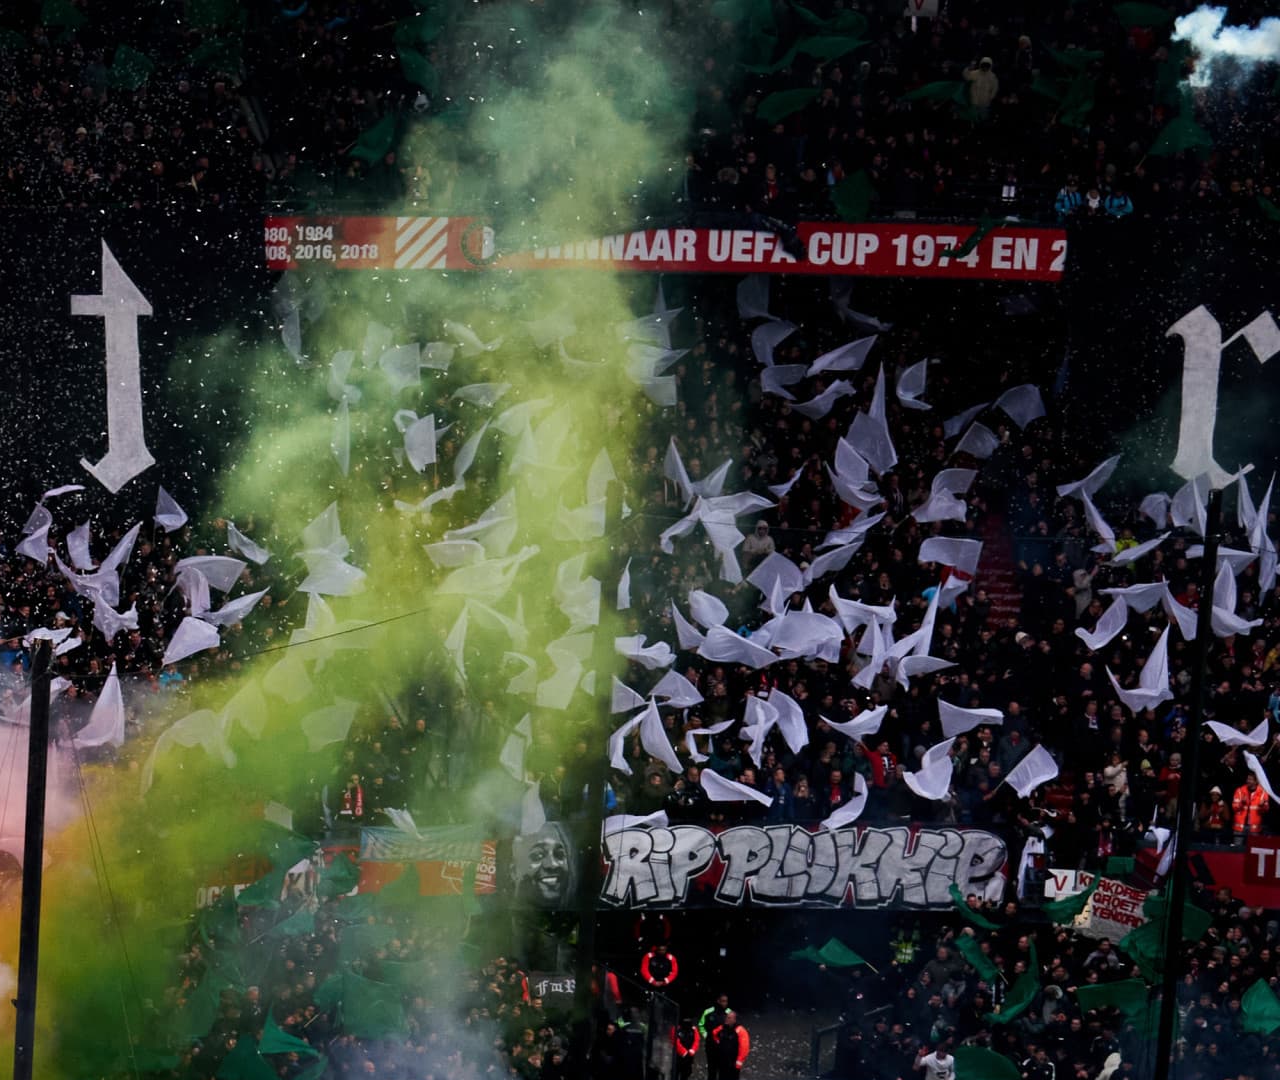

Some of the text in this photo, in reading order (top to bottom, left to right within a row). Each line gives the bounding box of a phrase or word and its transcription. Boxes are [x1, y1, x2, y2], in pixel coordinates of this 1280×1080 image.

[296, 225, 334, 241] 1984
[295, 244, 337, 262] 2016,
[340, 244, 379, 260] 2018
[707, 229, 798, 264] UEFA
[808, 231, 880, 266] CUP
[991, 236, 1039, 271] EN
